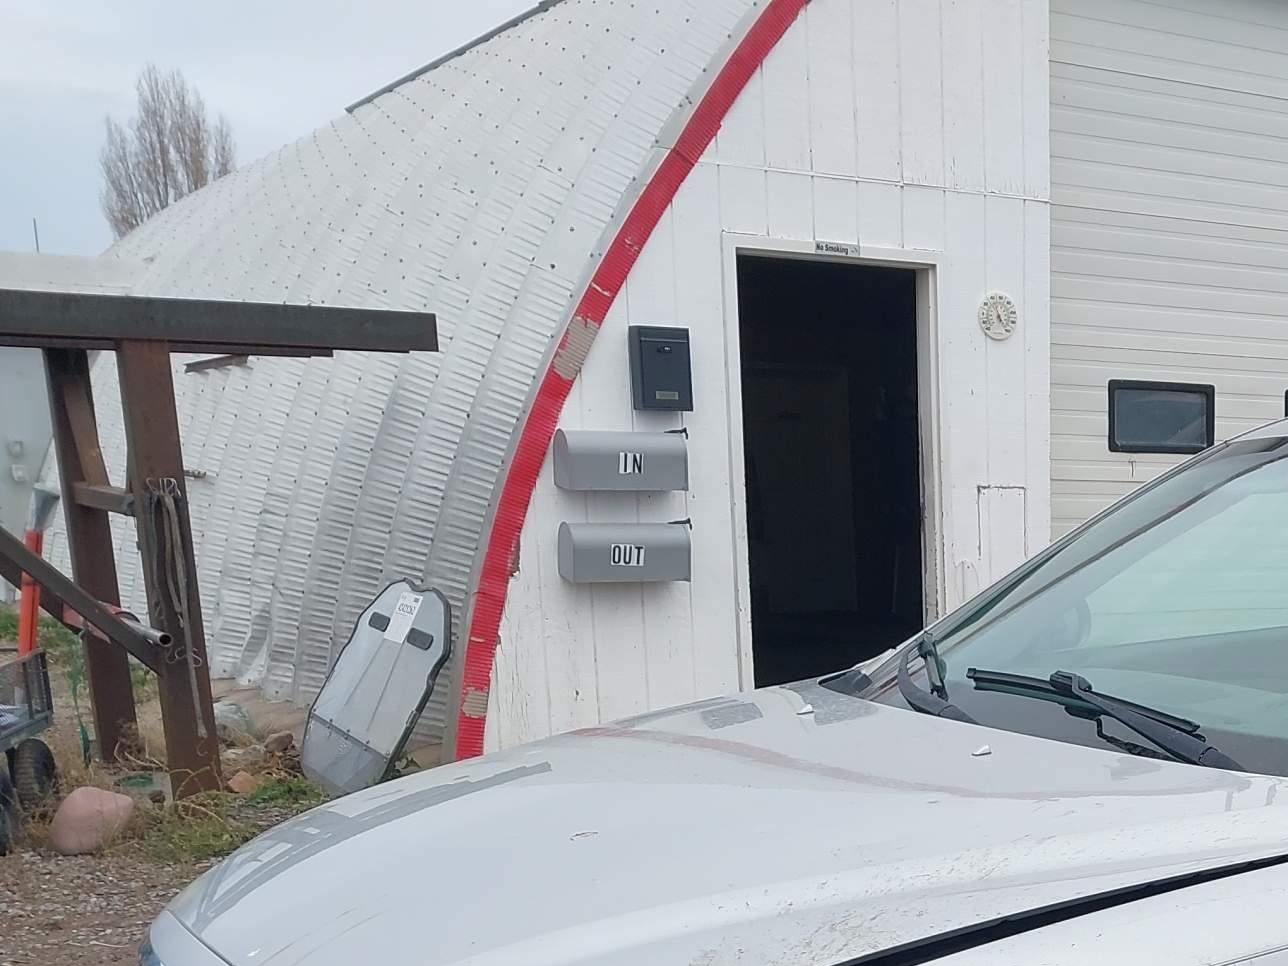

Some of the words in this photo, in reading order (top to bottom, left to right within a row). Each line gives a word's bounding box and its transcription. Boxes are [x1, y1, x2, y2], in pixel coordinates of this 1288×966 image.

[816, 243, 824, 251] No
[825, 244, 849, 255] Smoking
[624, 453, 642, 473] IN
[612, 545, 644, 565] OUT
